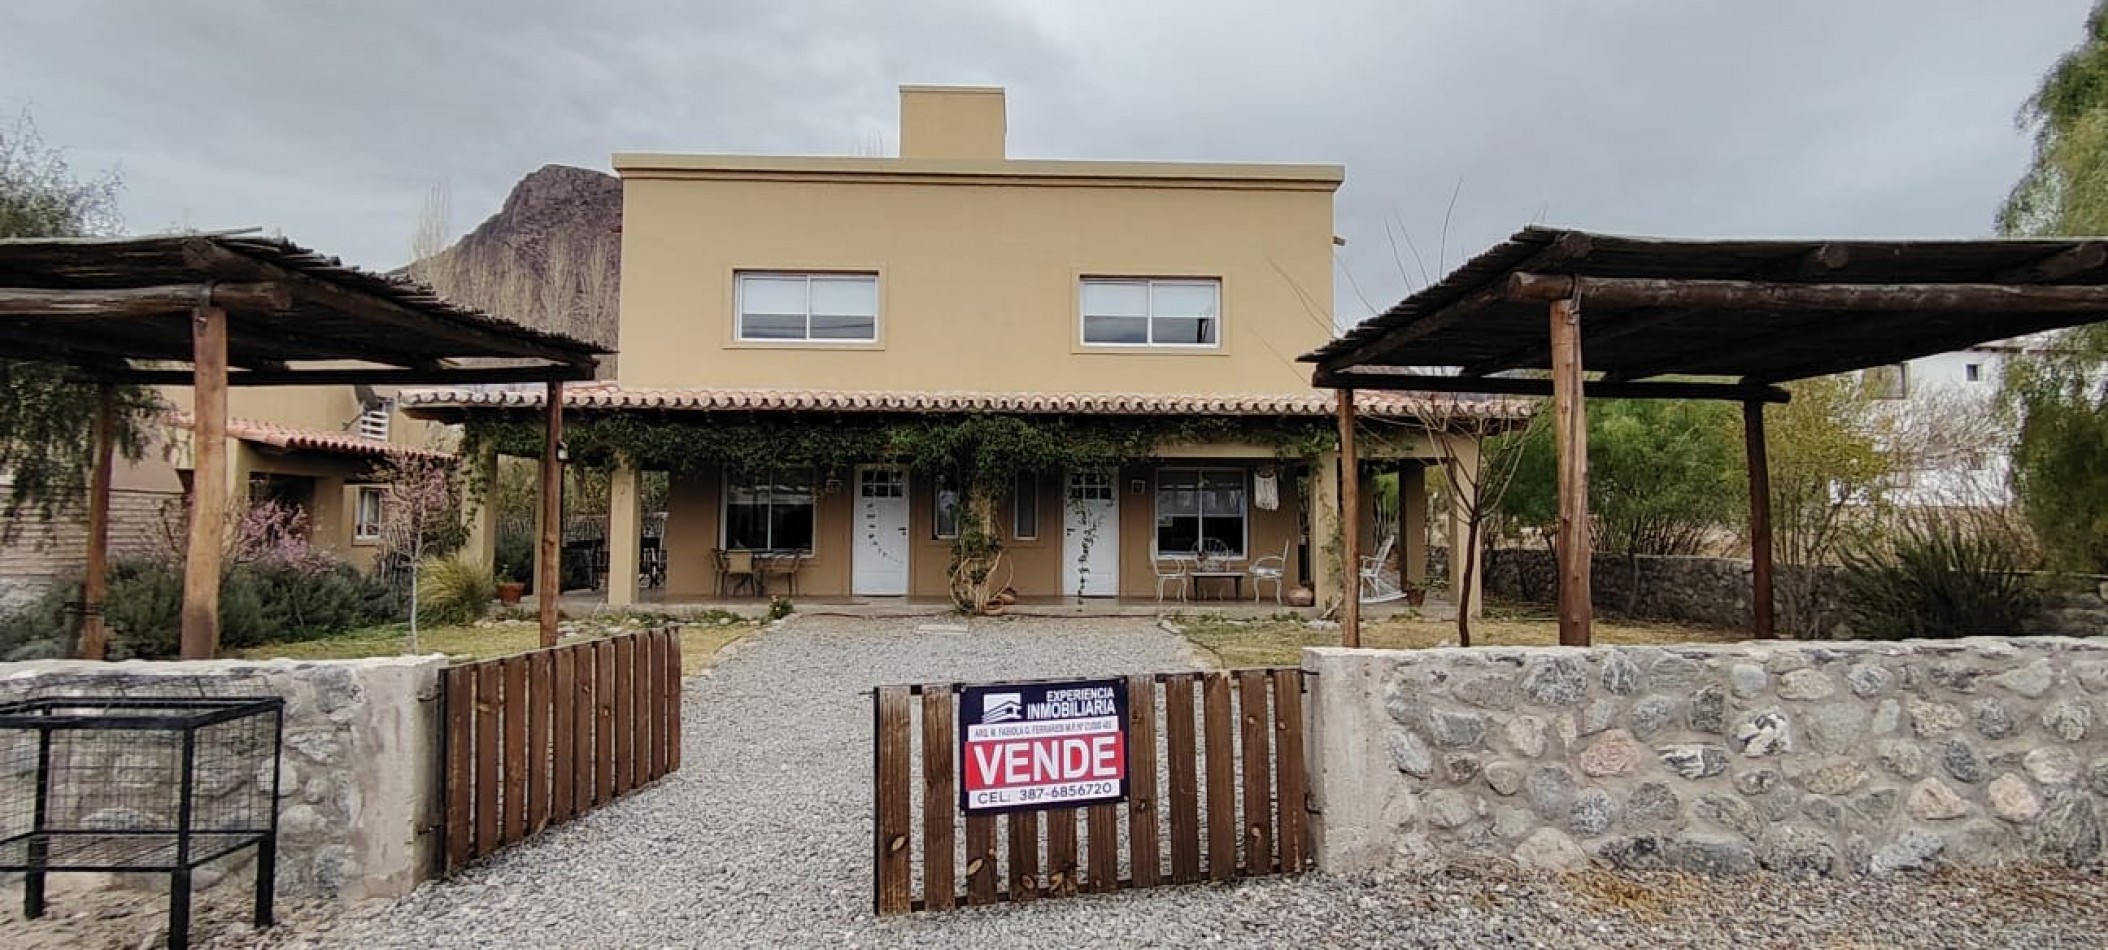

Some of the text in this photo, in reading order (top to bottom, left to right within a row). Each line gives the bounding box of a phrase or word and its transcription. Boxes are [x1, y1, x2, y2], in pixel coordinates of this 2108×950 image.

[1046, 687, 1115, 701] EXPERIENCIA
[1027, 700, 1116, 720] INMOBILIARIA
[973, 736, 1117, 785] VENDE
[977, 782, 1112, 805] CEL: 387-6856720
